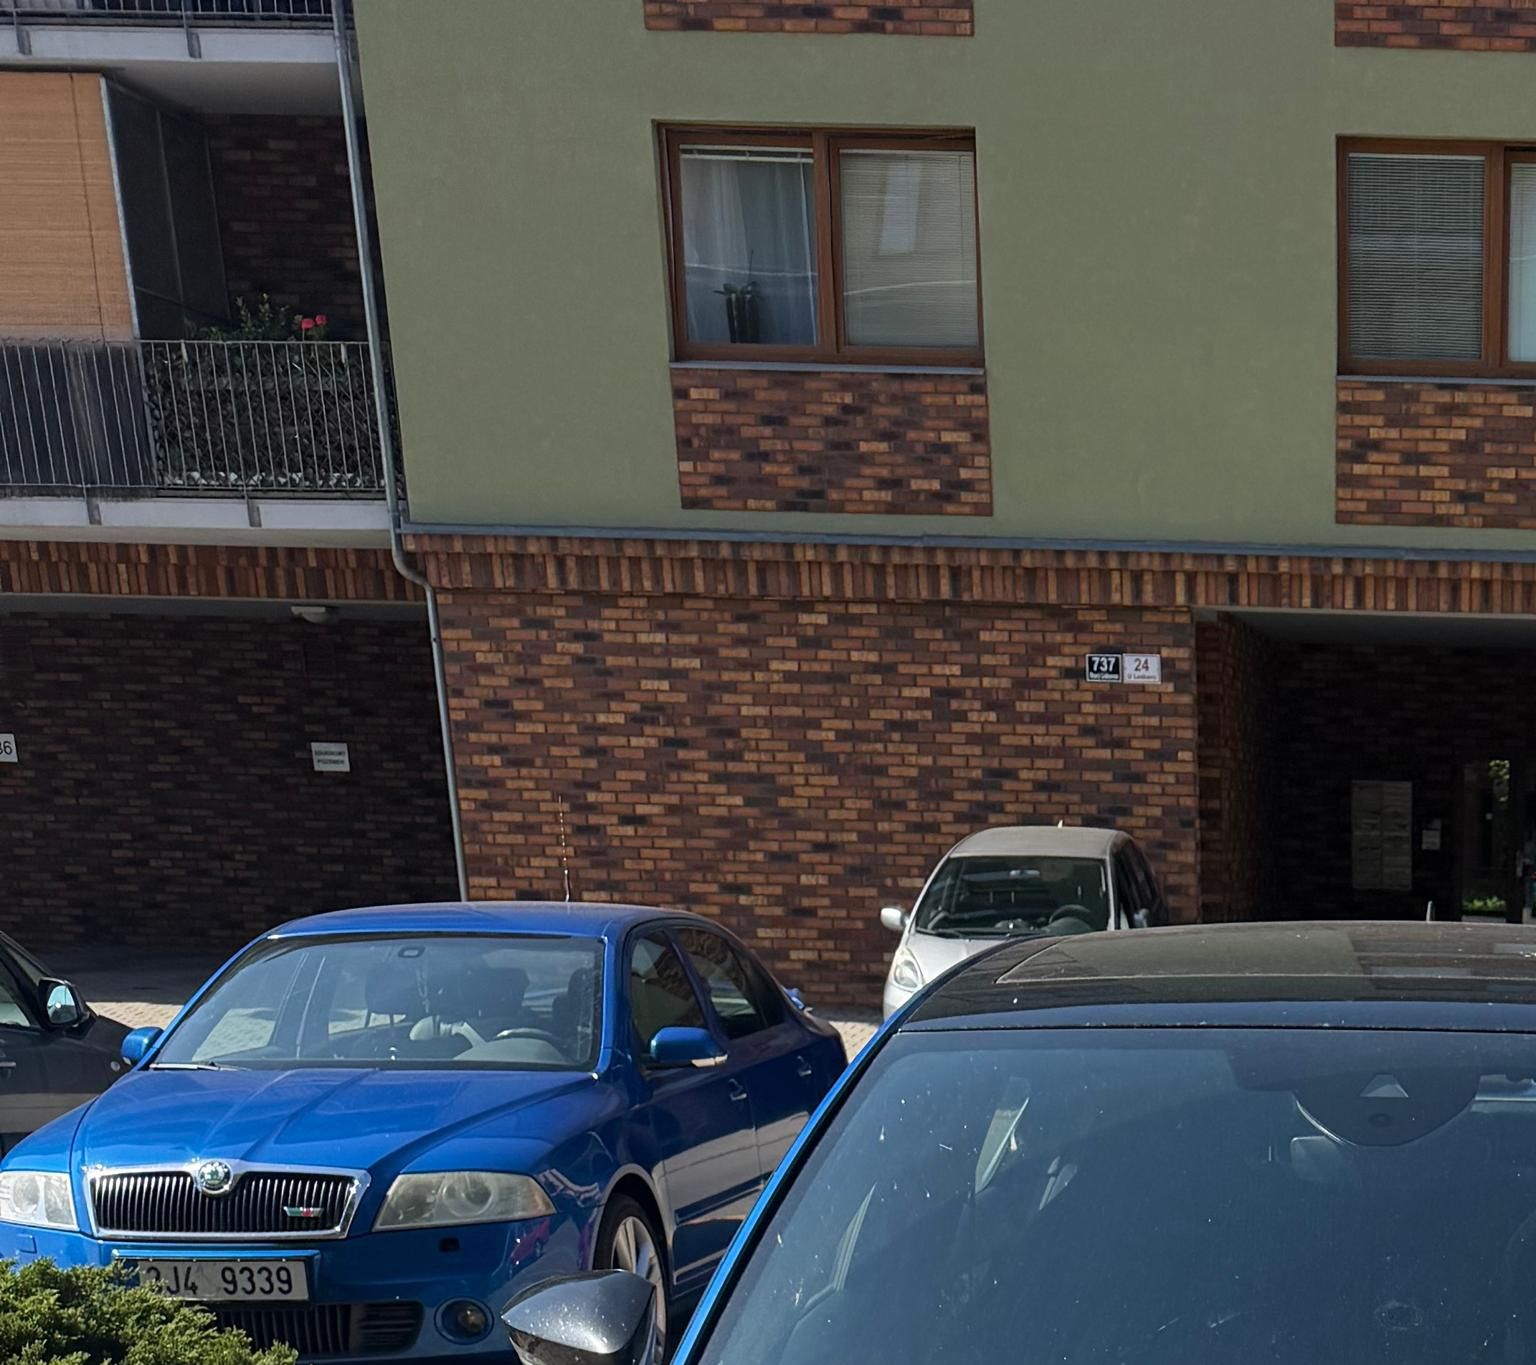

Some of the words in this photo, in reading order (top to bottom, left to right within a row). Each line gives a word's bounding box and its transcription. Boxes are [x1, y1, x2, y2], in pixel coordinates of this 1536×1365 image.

[1091, 656, 1116, 672] 737
[1134, 657, 1149, 672] 24
[220, 1266, 293, 1295] 9339
